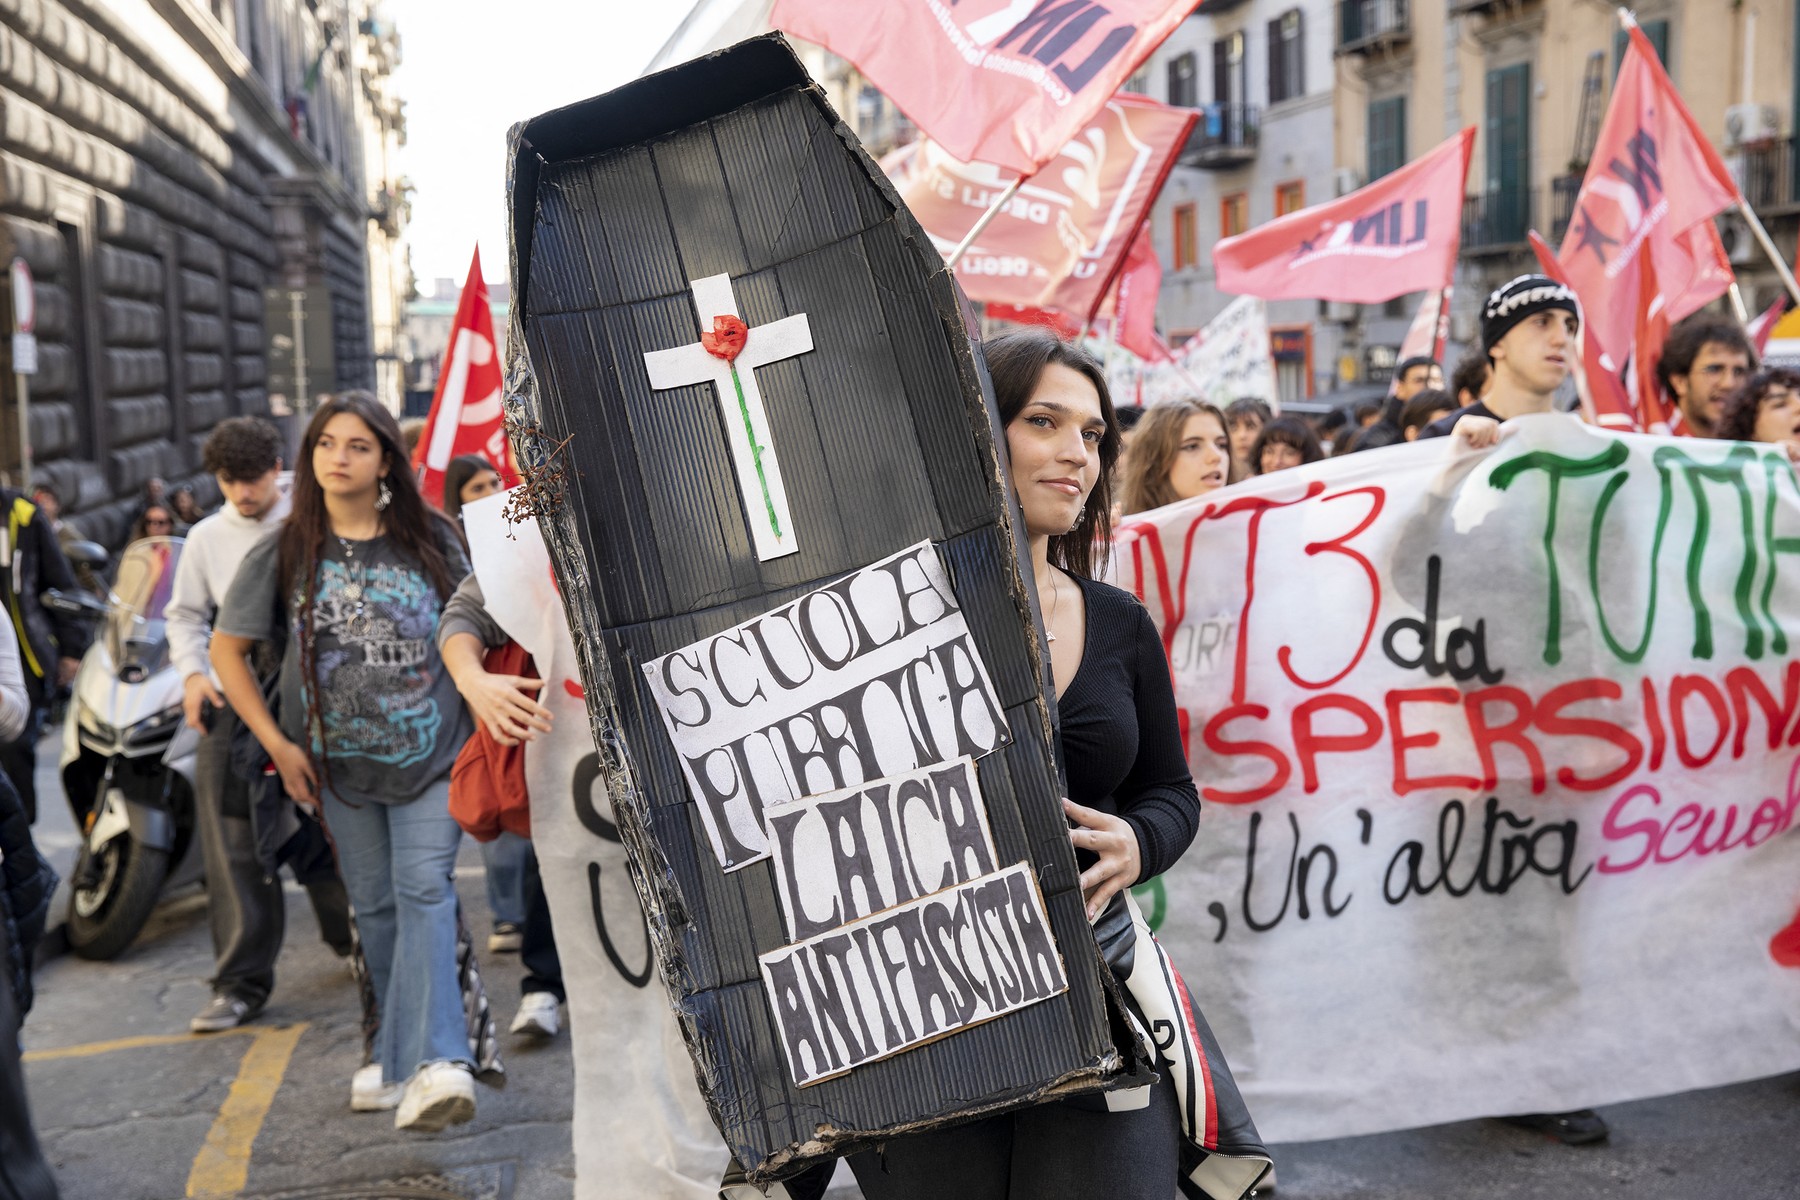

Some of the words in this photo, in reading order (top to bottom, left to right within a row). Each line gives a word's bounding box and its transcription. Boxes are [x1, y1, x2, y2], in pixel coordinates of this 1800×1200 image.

[661, 547, 961, 732] SCUOLA
[1381, 554, 1505, 684] da
[768, 762, 997, 942] LAICA
[764, 871, 1067, 1084] ANTIFASCISTA
